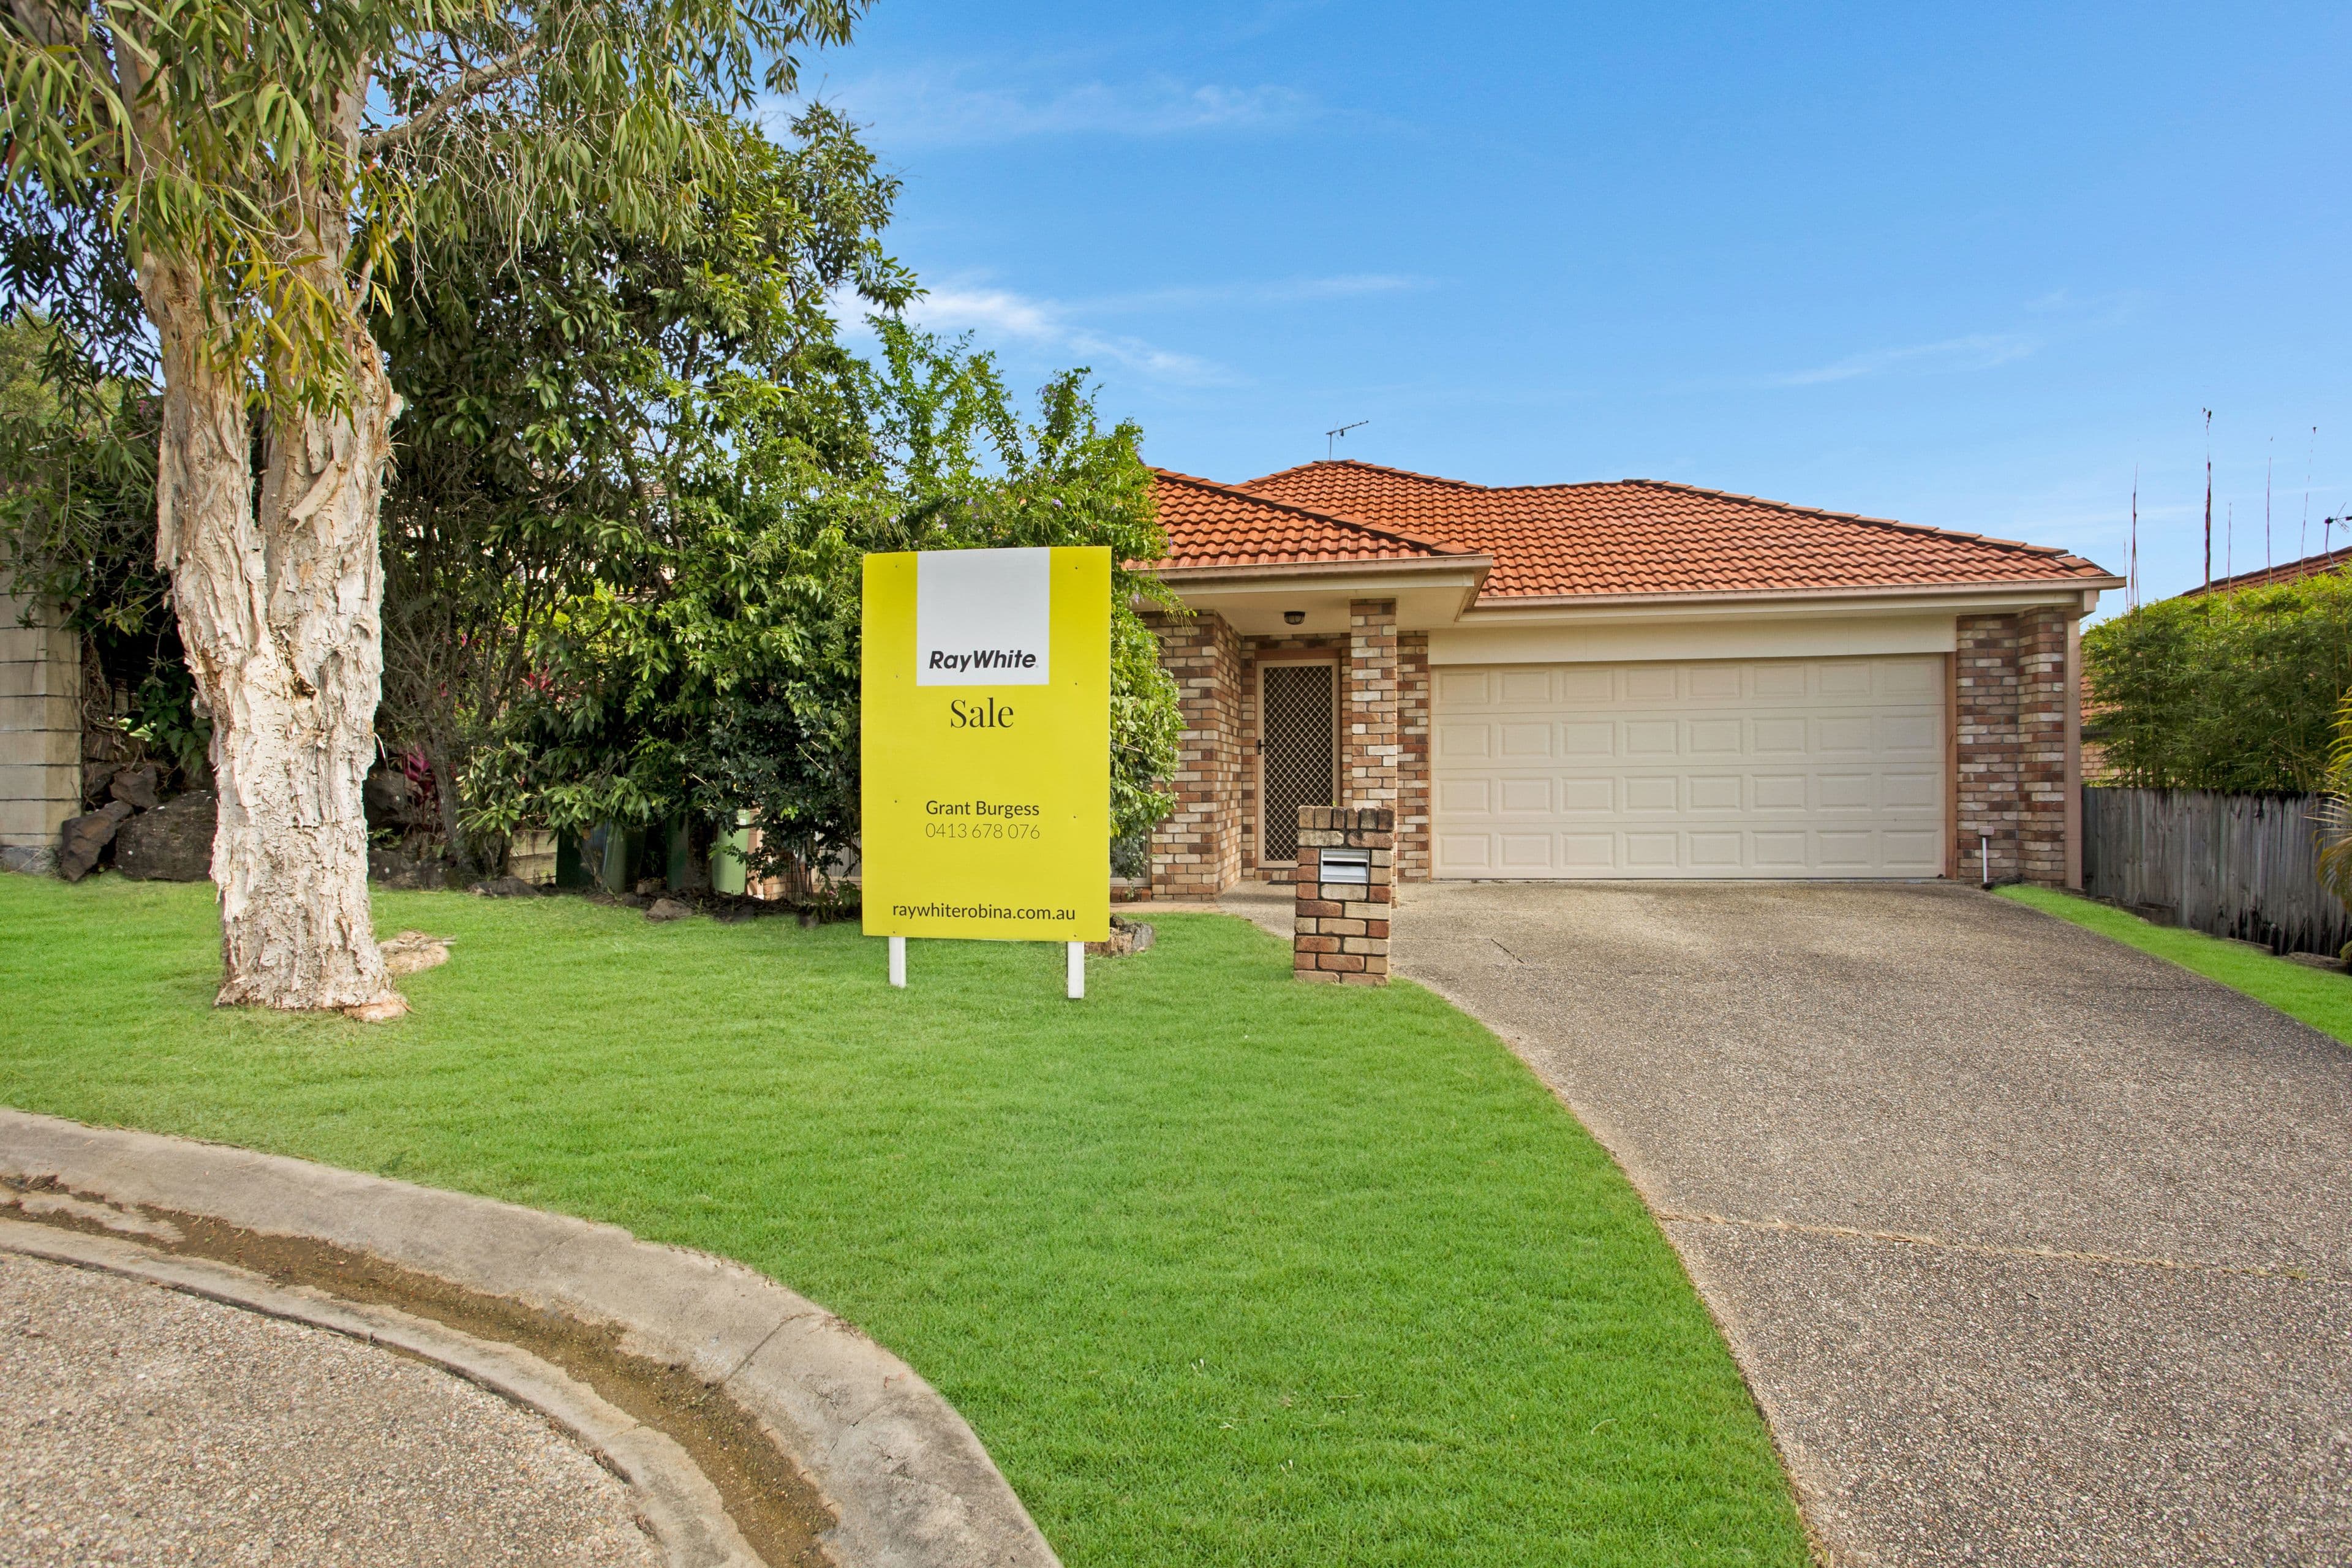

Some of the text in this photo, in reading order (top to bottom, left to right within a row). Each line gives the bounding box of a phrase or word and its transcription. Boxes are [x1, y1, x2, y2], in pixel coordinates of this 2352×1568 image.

[929, 649, 1037, 673] RayWhite
[951, 696, 1014, 728] Sale
[925, 800, 1040, 820] Grant Burgess
[925, 823, 1041, 840] 0413 678 076
[892, 902, 1076, 921] raywhiterobina.com.au
